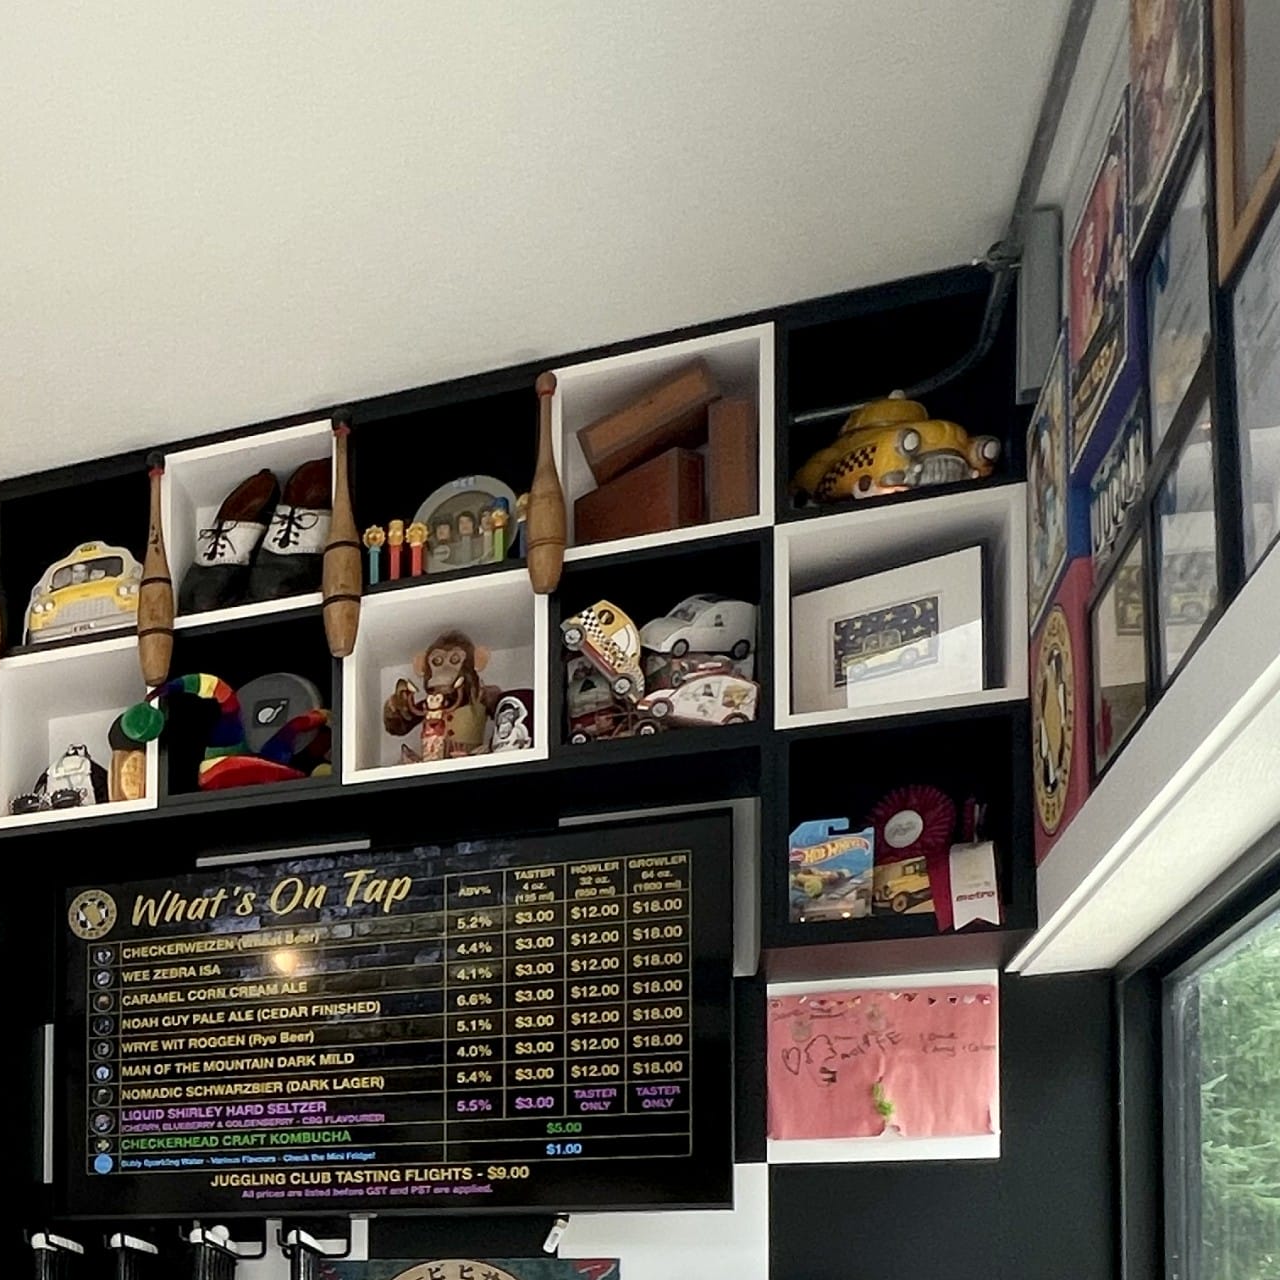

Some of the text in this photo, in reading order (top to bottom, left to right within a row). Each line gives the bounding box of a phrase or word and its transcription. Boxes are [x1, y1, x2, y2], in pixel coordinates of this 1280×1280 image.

[514, 868, 556, 880] TASTER
[570, 862, 620, 875] HOWLER
[628, 855, 687, 869] GROWLER
[131, 886, 257, 927] What's
[270, 877, 326, 915] On
[343, 869, 413, 913] Tap
[458, 886, 491, 897] ABV%
[956, 890, 994, 902] metro
[122, 938, 234, 960] CHECKERWEIZEN
[457, 916, 492, 930] 5.2%
[514, 910, 554, 925] $3.00
[570, 903, 620, 920] $12.00
[632, 898, 682, 914] $18.00
[121, 924, 682, 983] WEE ZEBRA ISA 4.4% $3.00 $12.00 $18.00
[122, 951, 682, 1006] CARAMEL CORN CREAM ALE 4.1% $3.00 $12.00 $18.00
[121, 979, 682, 1029] NOAH GUY PALE ALE (CEDAR FINISHED) 6.6% $3.00 $12.00 $18.00
[121, 1005, 682, 1054] WRYE WIT ROGGEN (Rye Beer) 5.1% $3.00 $12.00 $18.00
[121, 1033, 682, 1078] MAN OF THE MOUNTAIN DARK MILD 4.0% $3.00 $12.00 $18.00
[121, 1060, 682, 1100] NOMADIC SCHWARZBIER (DARK LAGER) 5.4% $3.00 $12.00 $18.00
[574, 1085, 681, 1099] TASTER TASTER
[121, 1096, 554, 1122] LIQUID SHIRLEY HARD SELTZER 5.5% $3.00
[580, 1098, 674, 1111] ONLY ONLY
[121, 1121, 582, 1150] CHECKERHEAD CRAFT KOMBUCHA $5.00
[546, 1143, 582, 1155] $1.00
[211, 1165, 530, 1187] JUGGLING CLUB TASTING FLIGHTS $9.00
